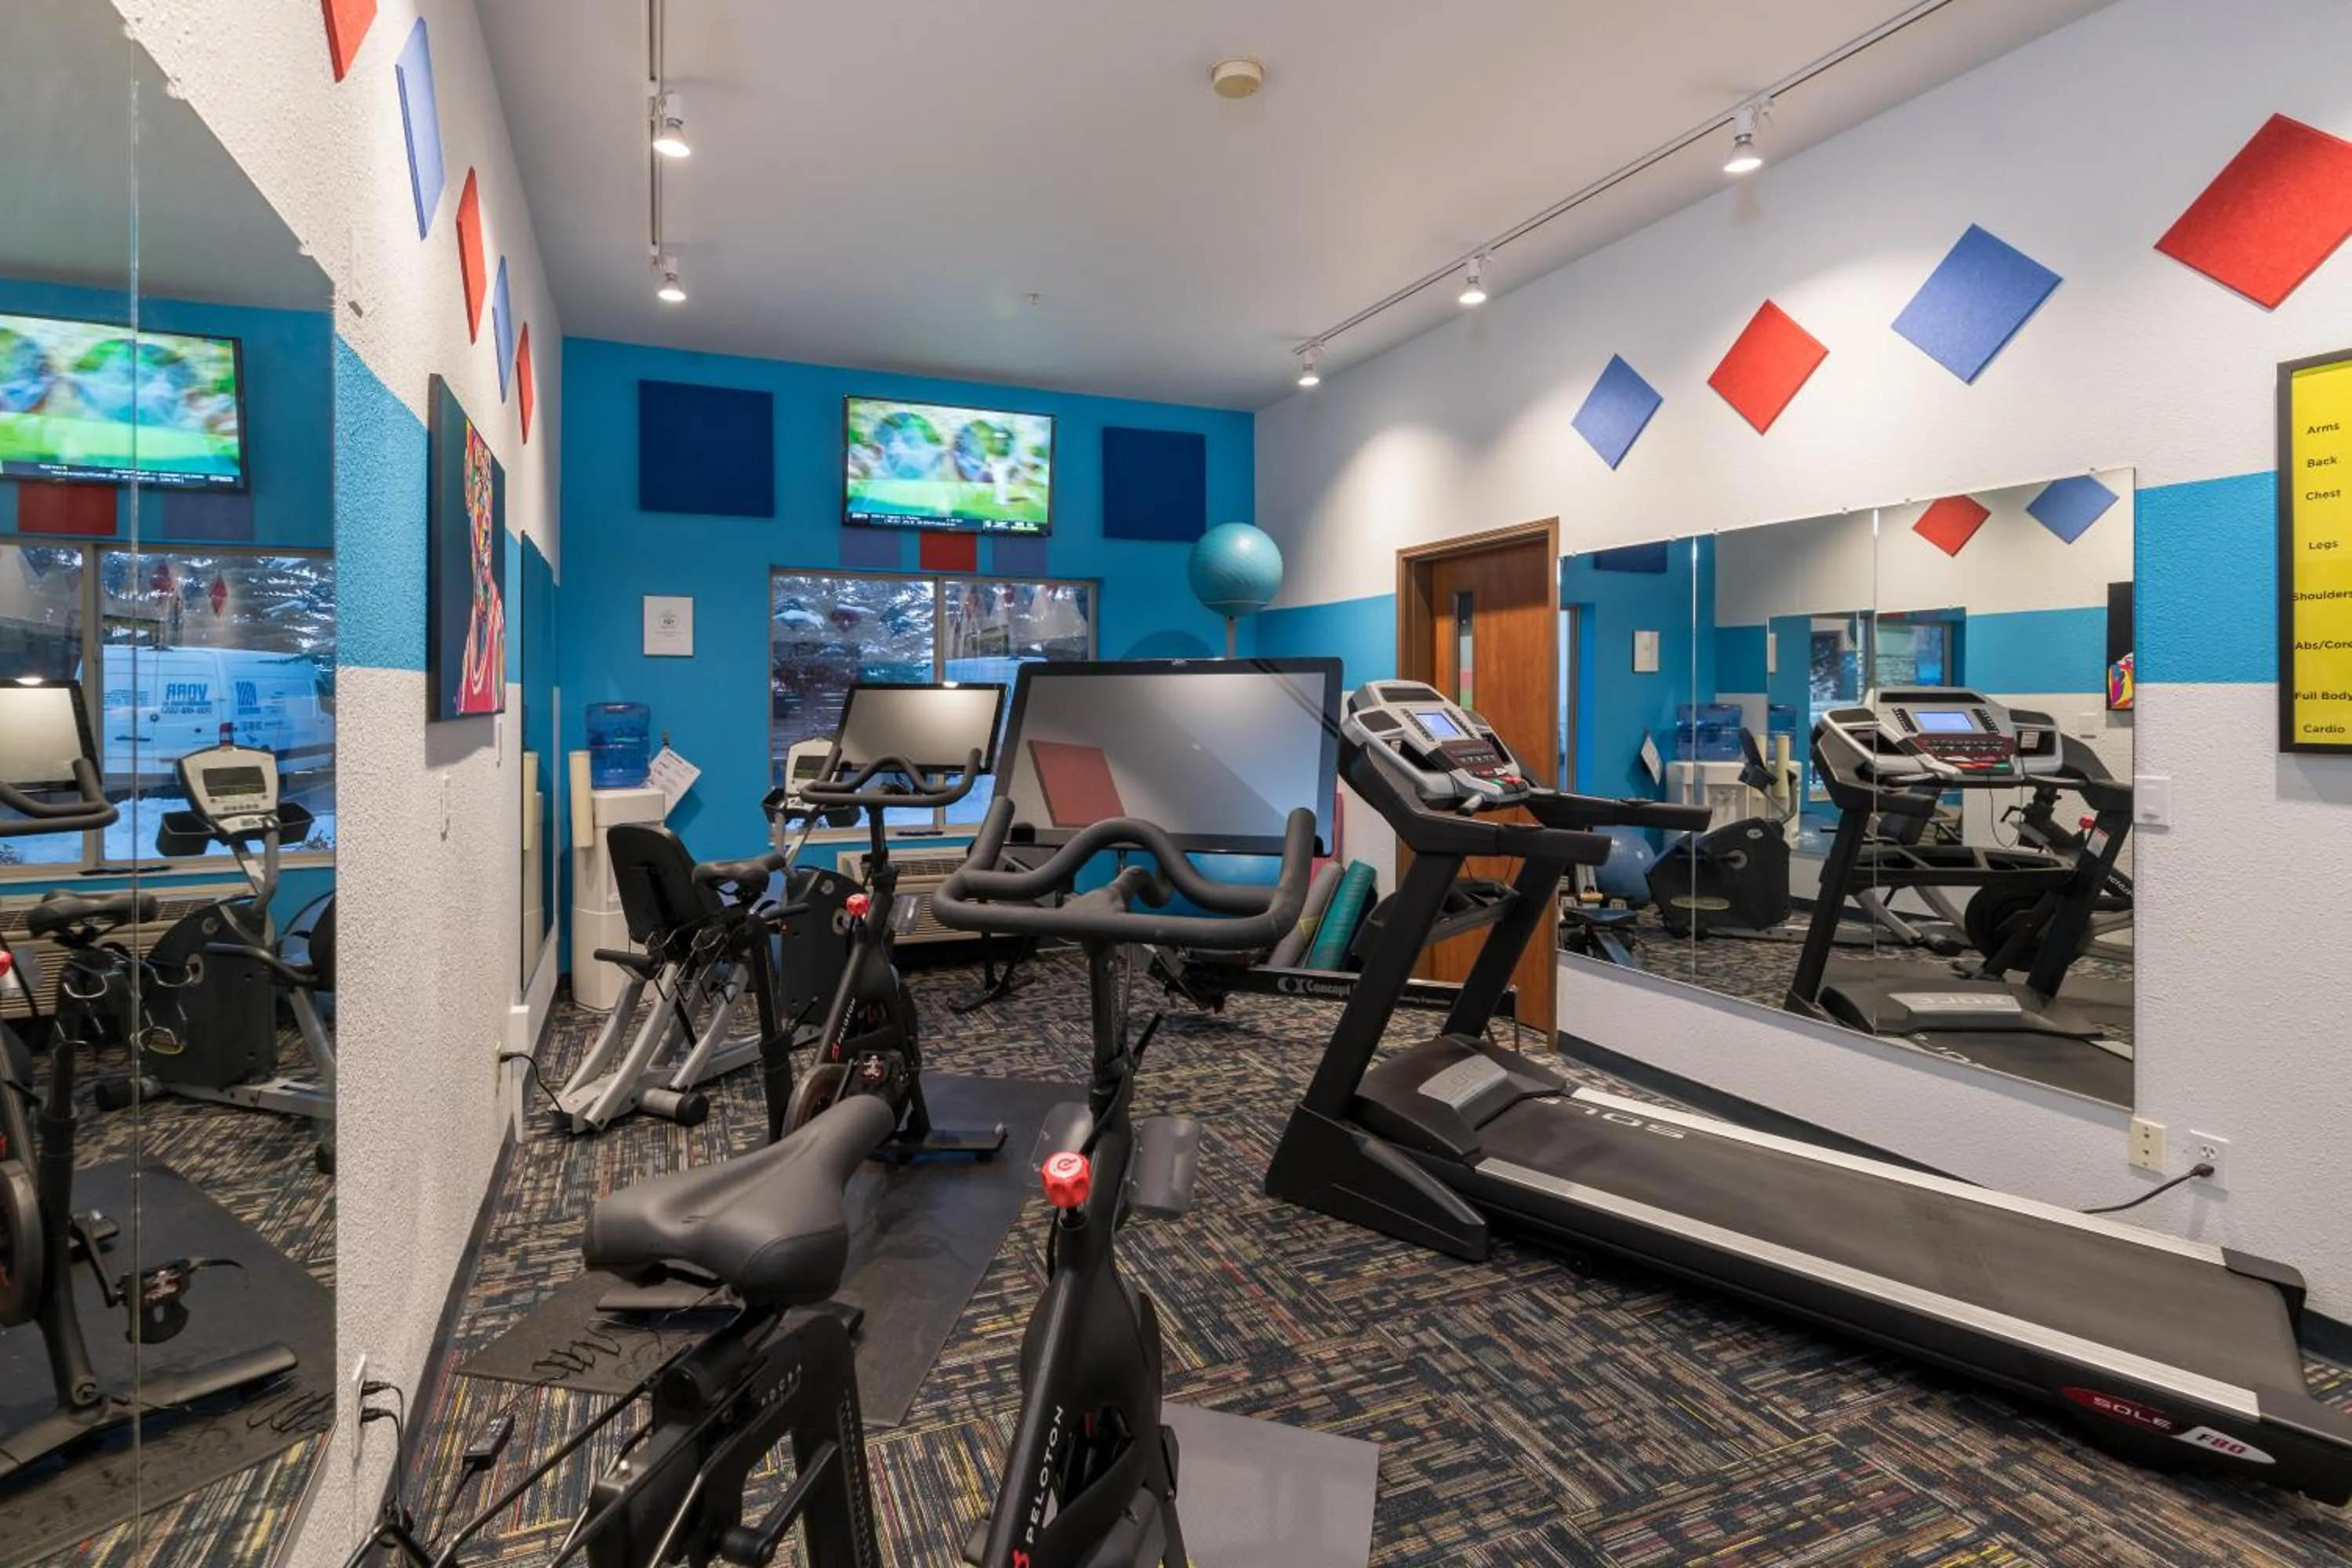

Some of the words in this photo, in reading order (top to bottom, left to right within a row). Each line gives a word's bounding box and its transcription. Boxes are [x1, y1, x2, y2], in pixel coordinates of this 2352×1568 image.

[2307, 423, 2339, 434] Arms
[2307, 456, 2336, 468] Back
[2306, 489, 2340, 500] Chest
[2309, 540, 2339, 550] Legs
[2295, 691, 2317, 700] Full
[2321, 691, 2352, 702] Body
[2303, 724, 2346, 733] Cardio
[1307, 979, 1350, 997] Concept
[2094, 1396, 2172, 1430] SOLE
[2197, 1433, 2245, 1454] F80
[1025, 1404, 1065, 1544] PELOTON
